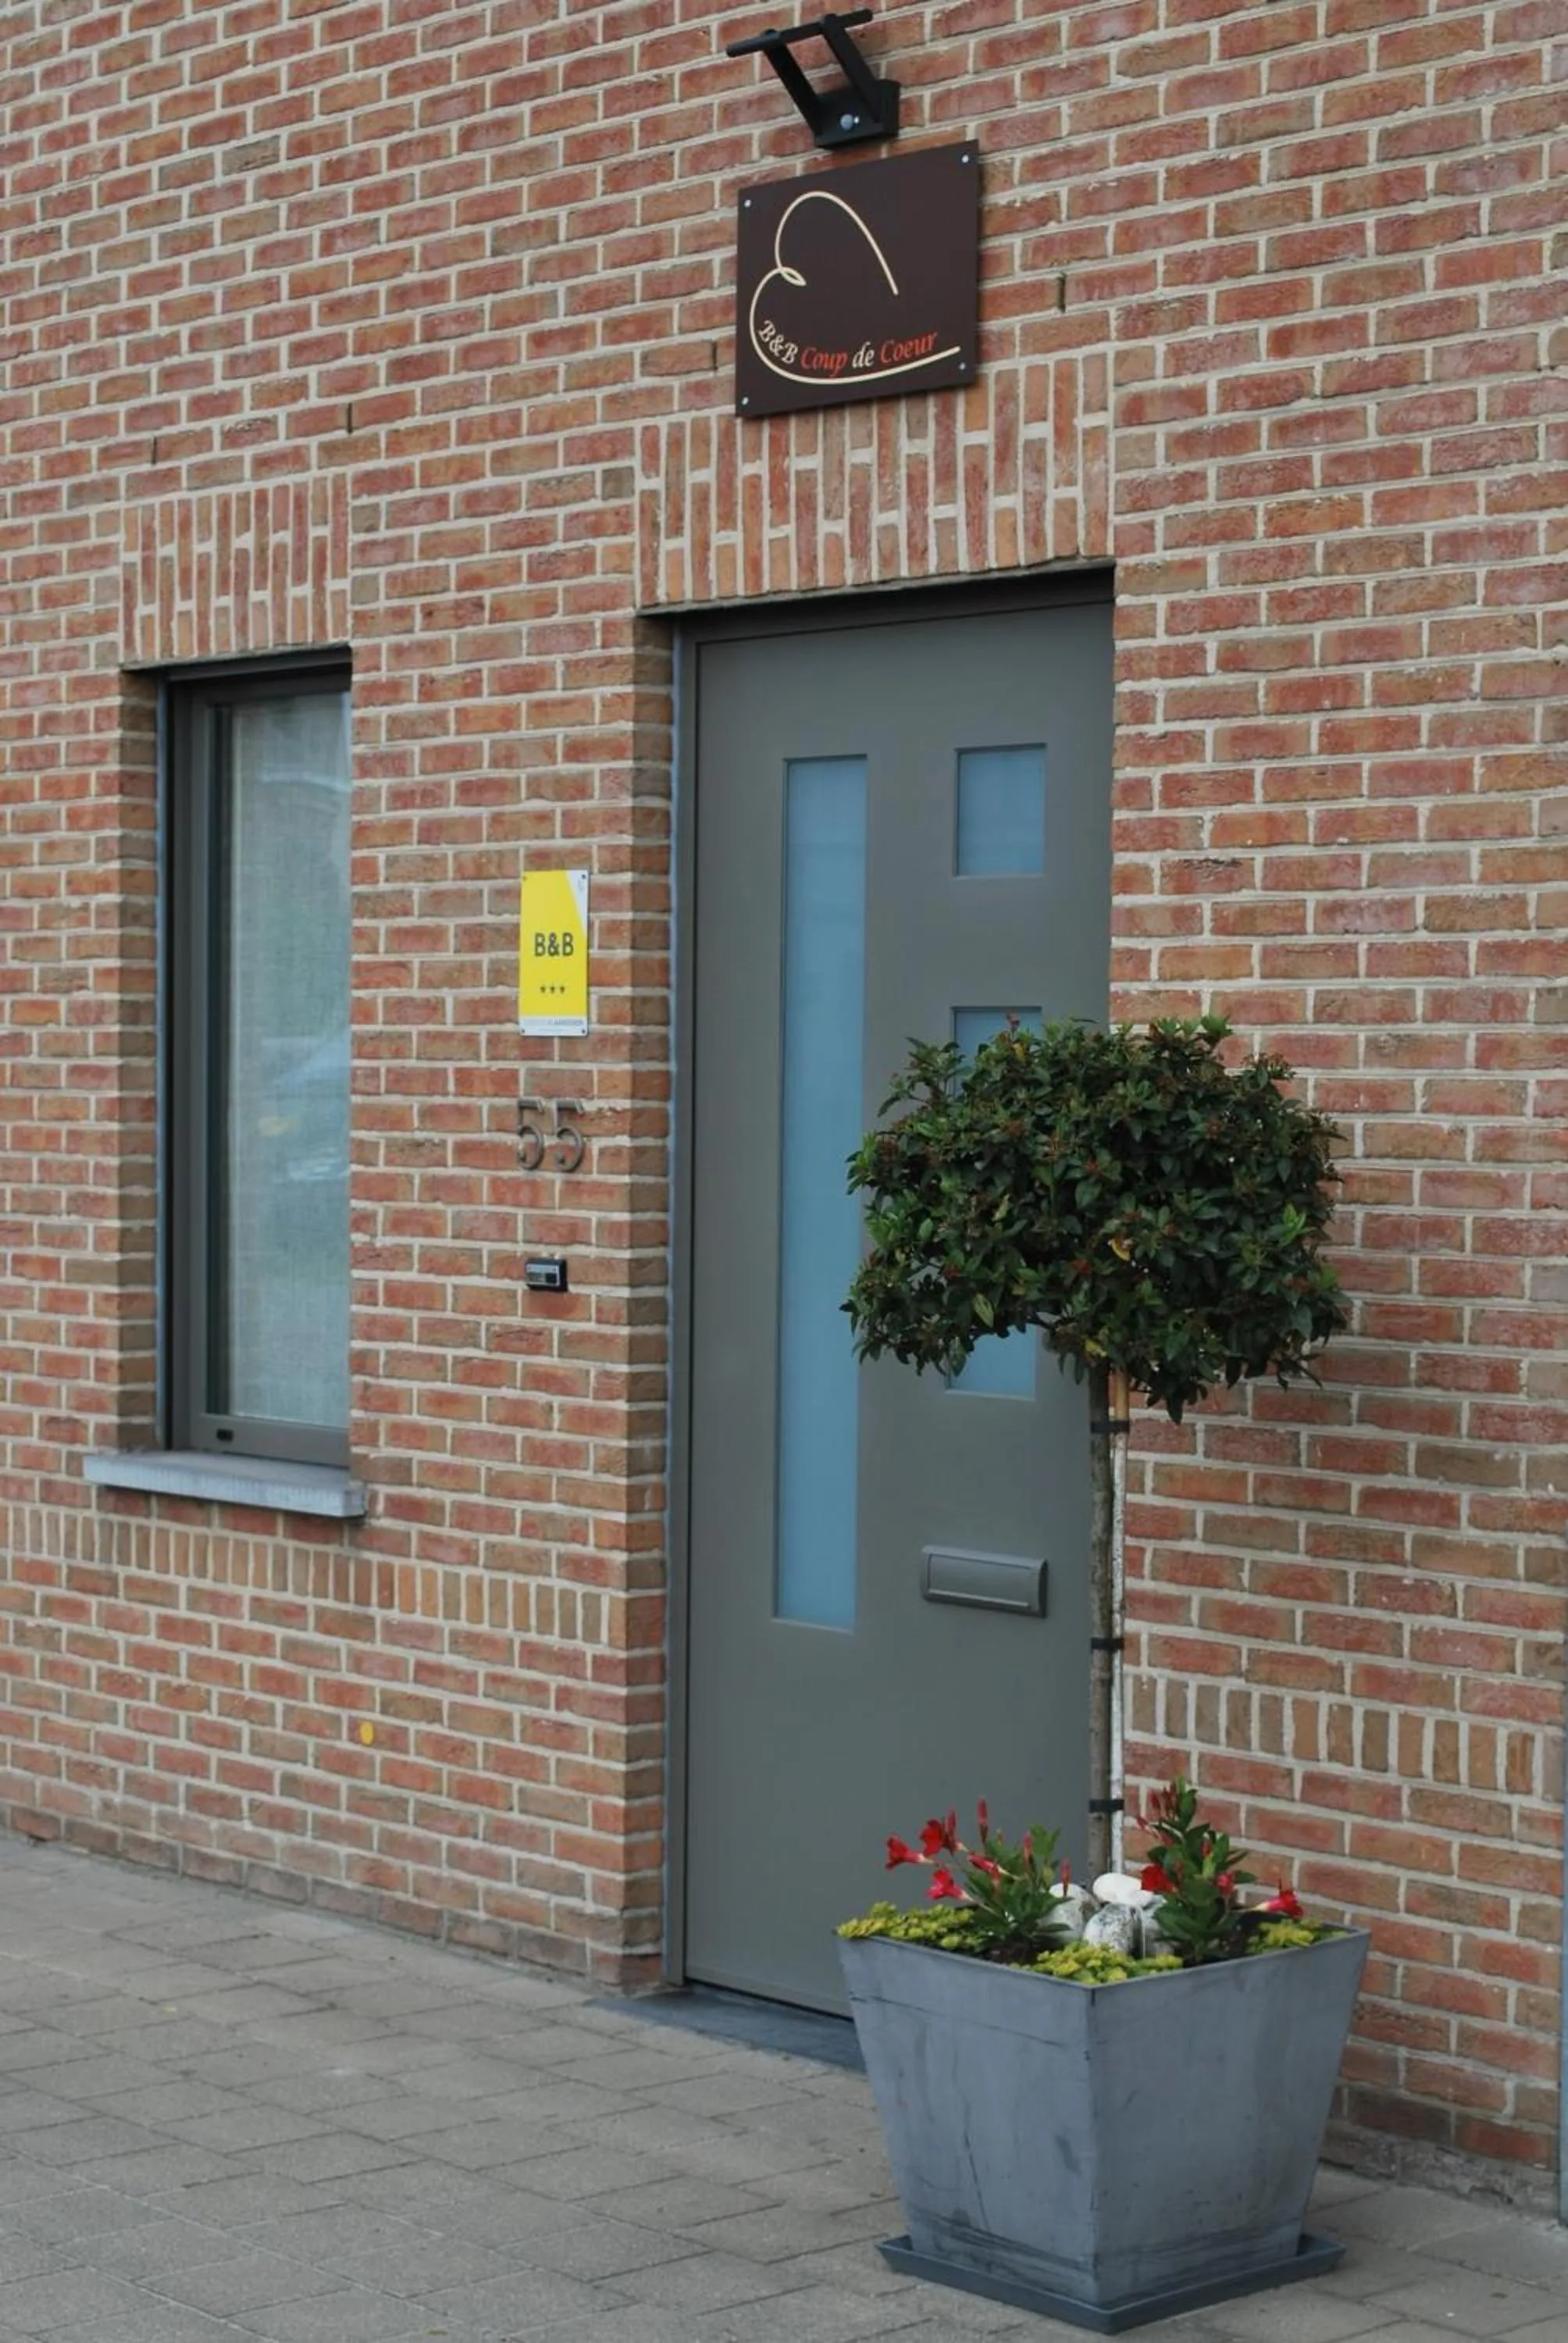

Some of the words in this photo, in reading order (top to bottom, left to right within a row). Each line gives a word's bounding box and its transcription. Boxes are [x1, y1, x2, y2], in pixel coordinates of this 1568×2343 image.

[758, 320, 798, 364] B&B
[800, 346, 849, 377] Coup
[852, 341, 875, 369] de
[880, 331, 939, 364] Coeur
[534, 932, 574, 957] B&B
[515, 1097, 583, 1172] 55
